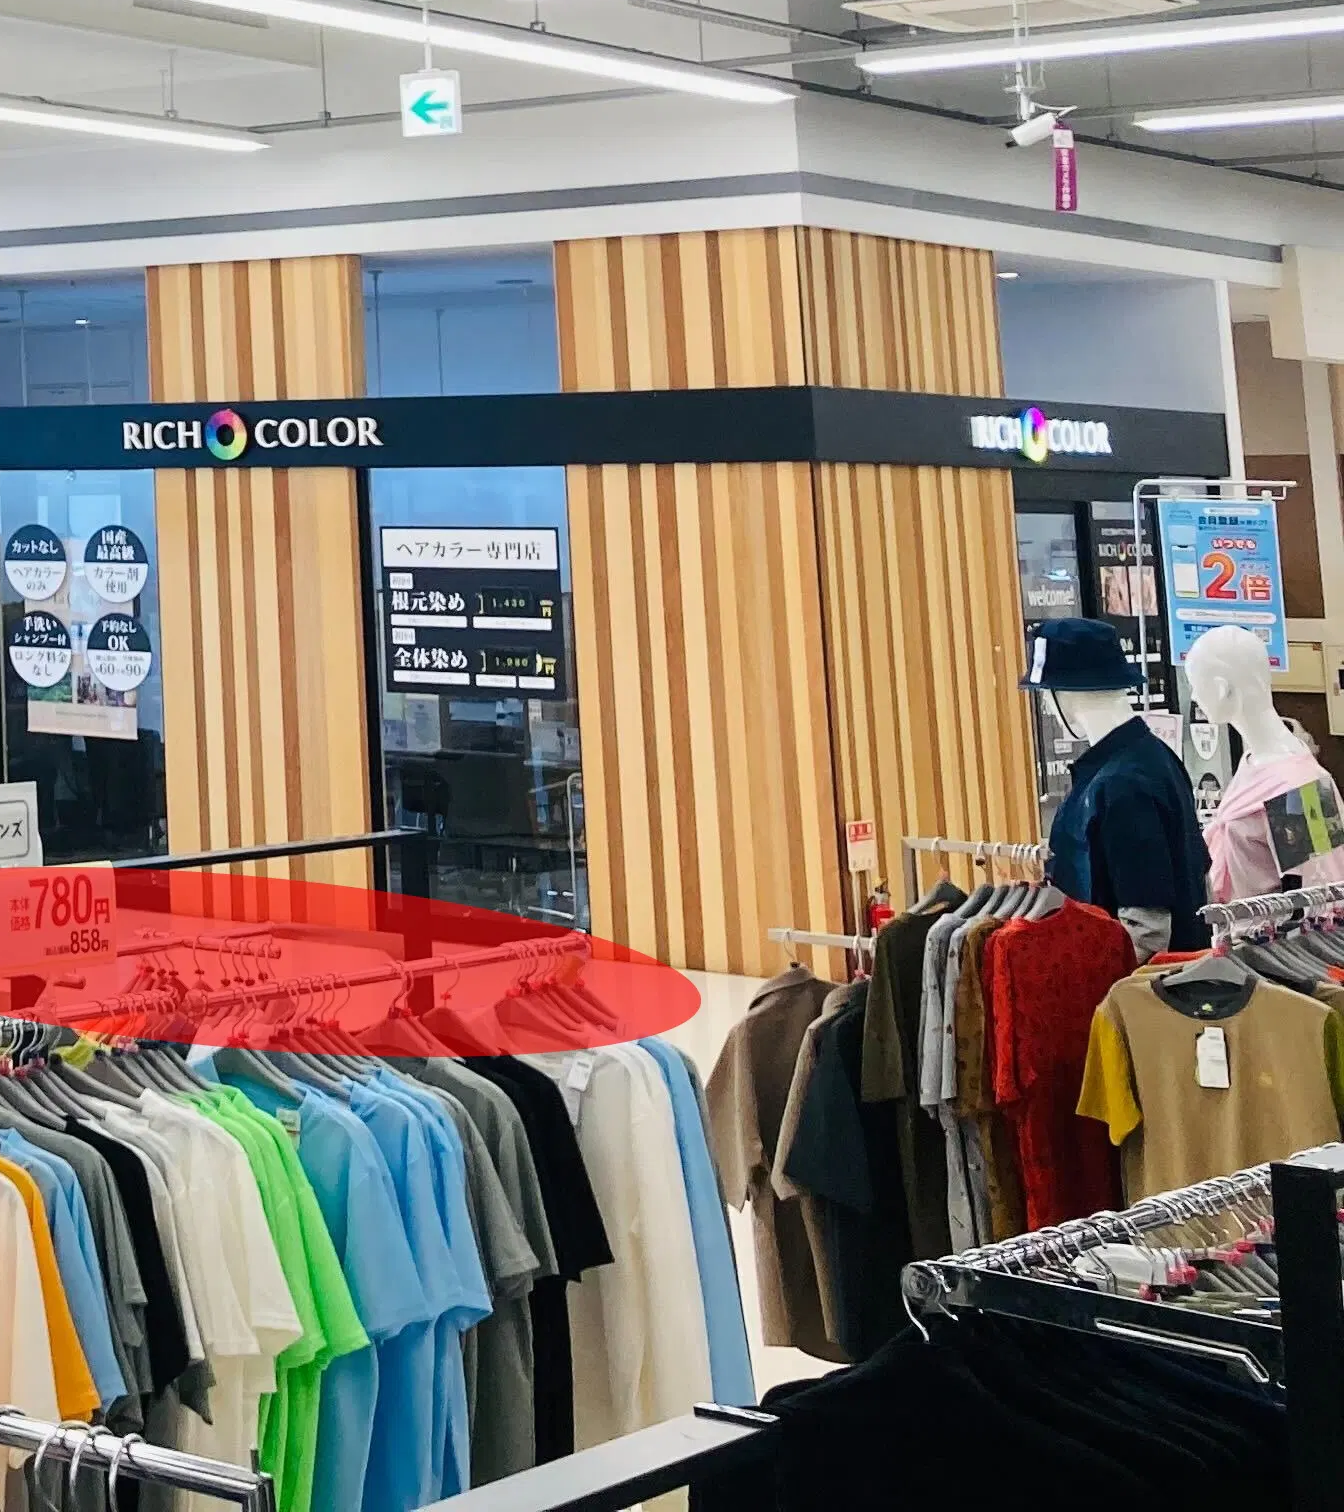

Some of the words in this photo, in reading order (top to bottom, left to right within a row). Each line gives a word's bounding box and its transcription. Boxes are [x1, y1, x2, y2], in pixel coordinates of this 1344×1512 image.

[122, 420, 203, 450] RICH
[254, 416, 385, 449] COLOR
[970, 416, 1023, 450] RICH
[1047, 419, 1113, 454] COLOR
[12, 540, 59, 554] カットなし
[397, 541, 541, 561] ヘアカラー専門店
[1127, 543, 1153, 557] COOR
[1212, 539, 1257, 550] いつでも
[13, 566, 62, 577] ヘアカラー
[93, 567, 139, 582] カラー剤
[1202, 552, 1238, 600] 2
[26, 581, 47, 592] のみ
[106, 581, 127, 594] 使用
[1240, 574, 1272, 601] 倍
[391, 591, 466, 612] 根元染め
[1028, 585, 1076, 607] welcome!
[107, 635, 129, 651] OK
[14, 651, 68, 664] ロング料金
[394, 647, 468, 669] 全体染め
[33, 664, 52, 677] なし
